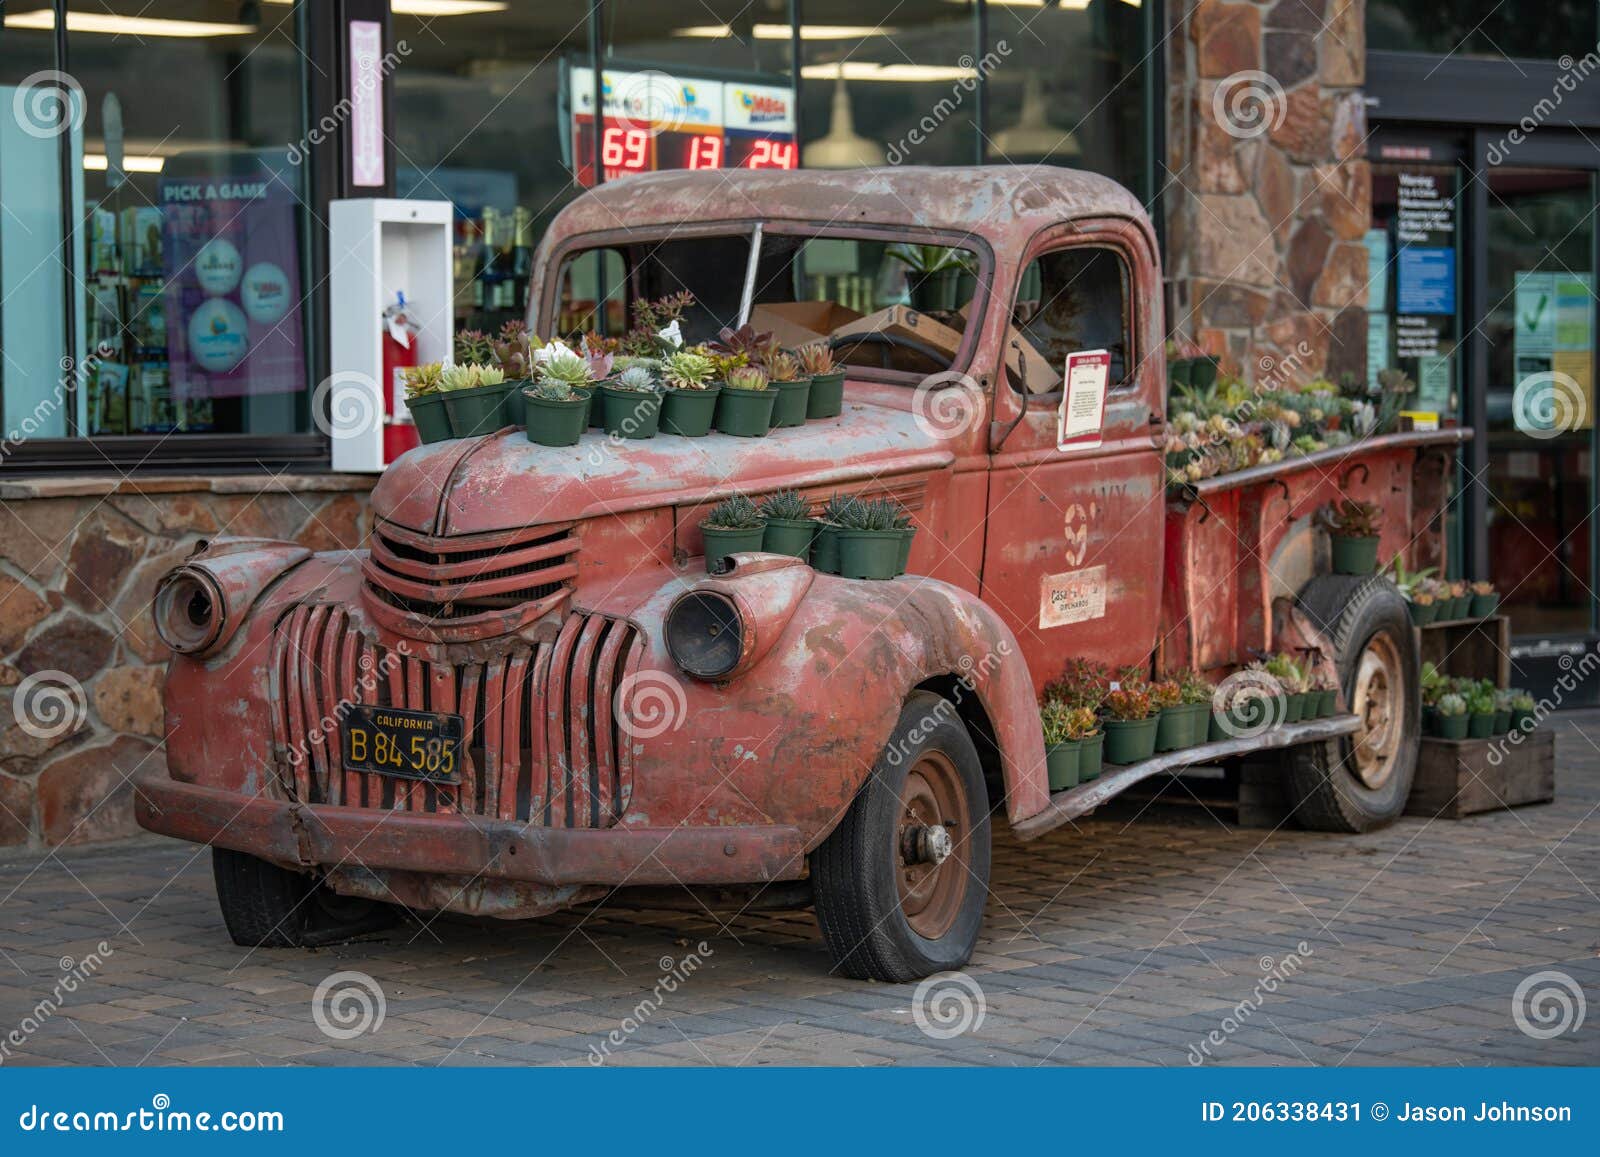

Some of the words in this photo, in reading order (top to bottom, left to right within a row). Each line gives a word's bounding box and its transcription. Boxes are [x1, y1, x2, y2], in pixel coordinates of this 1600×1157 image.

[602, 127, 648, 168] 69
[689, 136, 721, 169] 13
[750, 140, 793, 169] 24
[164, 185, 201, 201] PICK
[205, 184, 218, 200] A
[219, 182, 268, 200] GAME
[376, 714, 433, 731] CALIFORNIA
[350, 727, 368, 762] B
[374, 732, 403, 768] 84
[411, 736, 455, 774] 585
